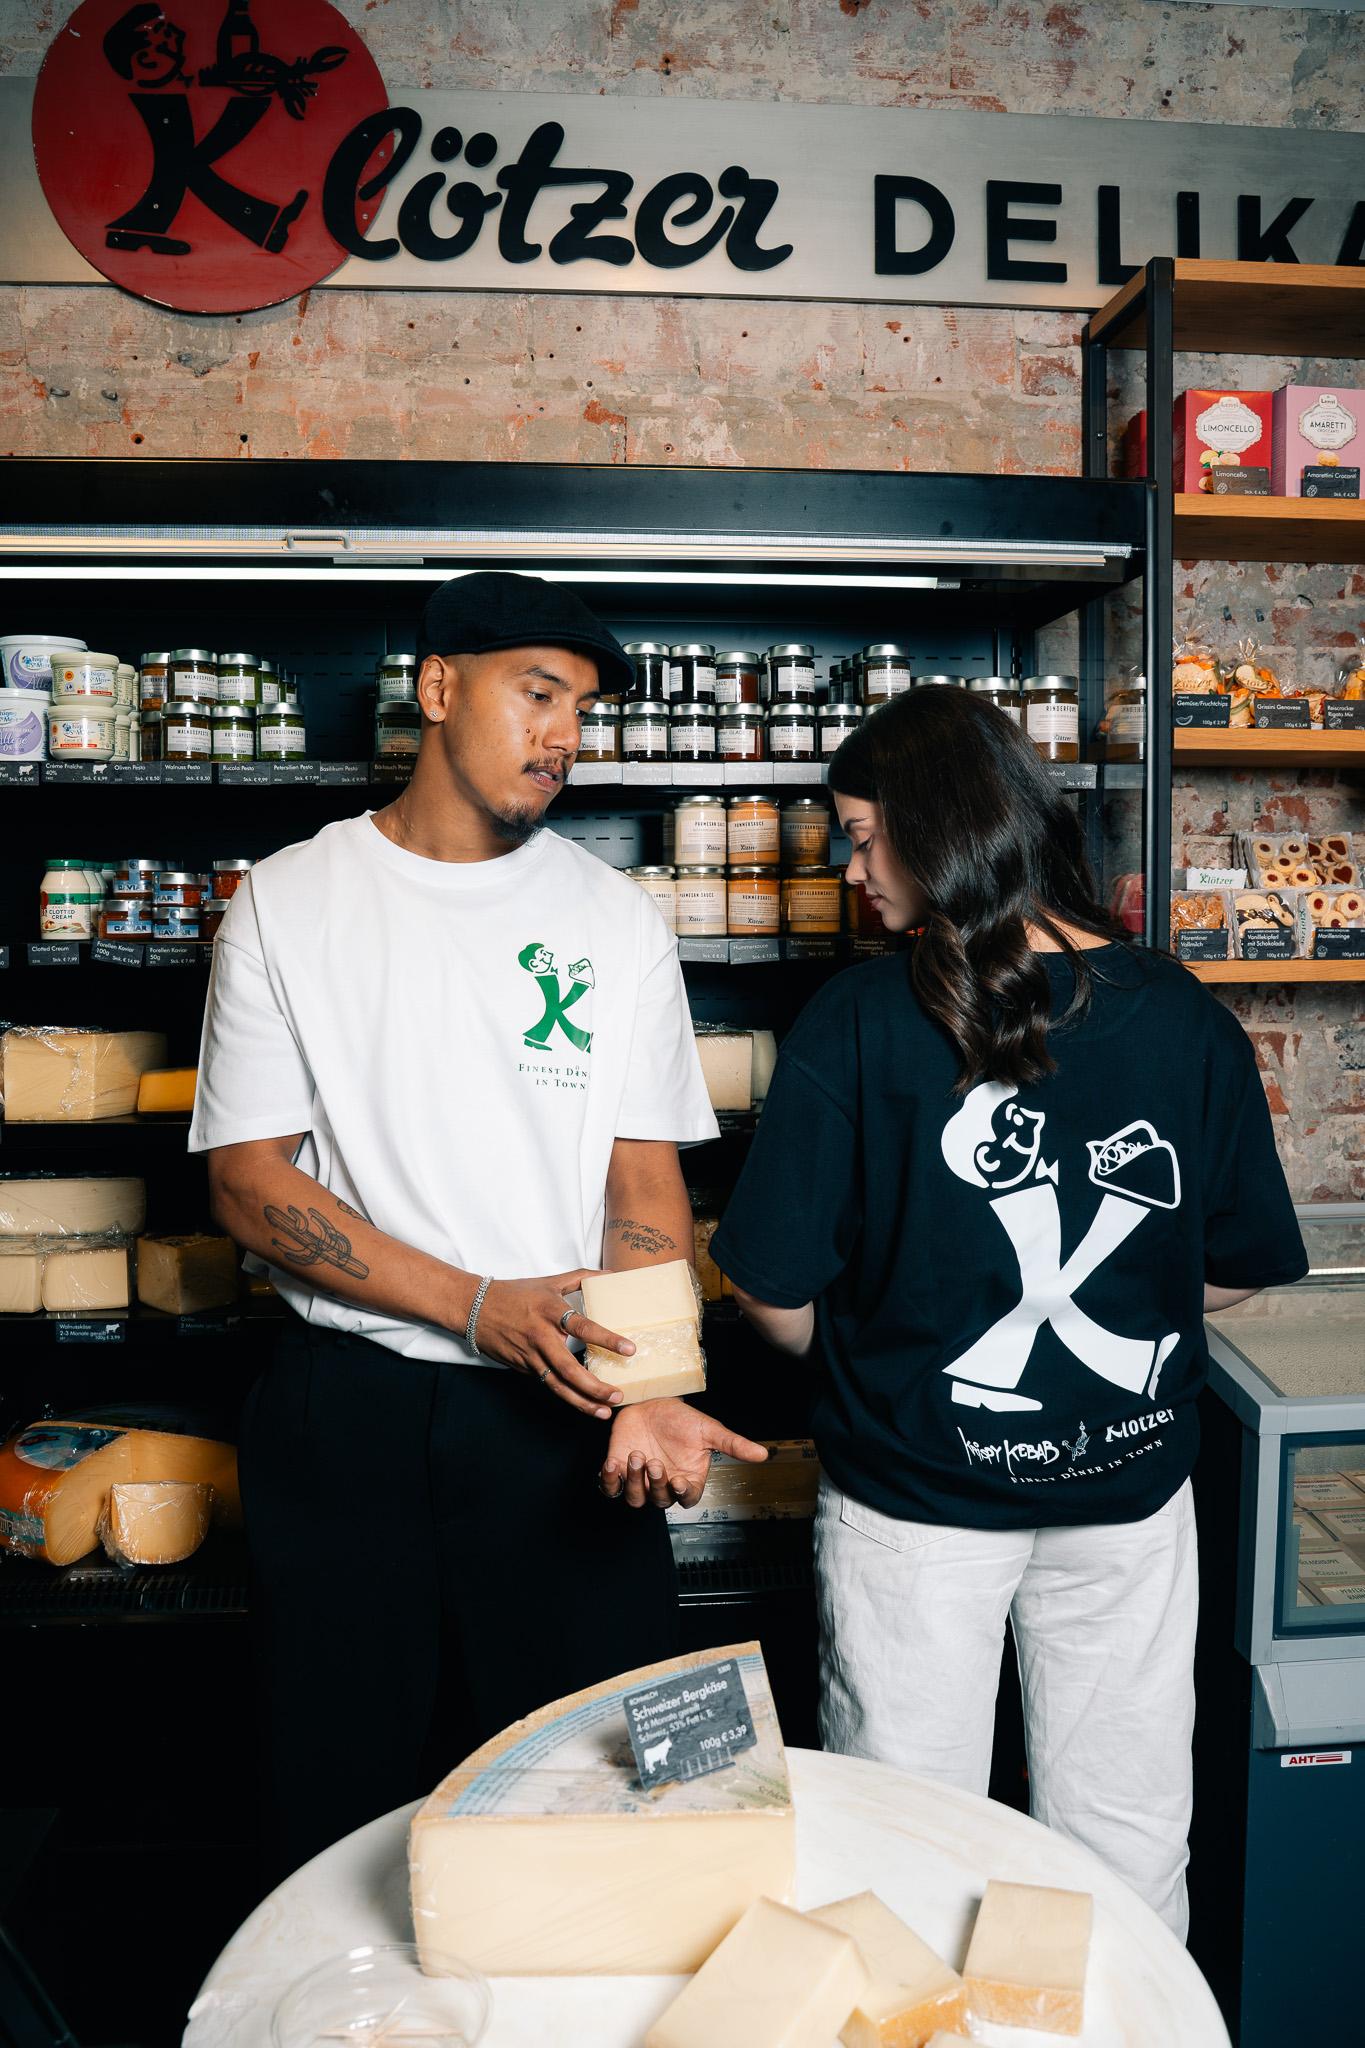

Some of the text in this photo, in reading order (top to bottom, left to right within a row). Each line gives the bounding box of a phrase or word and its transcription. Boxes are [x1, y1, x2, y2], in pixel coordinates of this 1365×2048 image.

[1203, 425, 1255, 433] LIMONCELLO
[1310, 421, 1347, 430] AMARETTI
[1215, 471, 1248, 479] Limoncello
[1200, 873, 1233, 885] Klötzer
[632, 1680, 728, 1722] Schweizer Bergkäse
[650, 1713, 678, 1728] Monate
[678, 1703, 700, 1719] gereift
[700, 1736, 721, 1751] 100g
[729, 1724, 748, 1740] 3,39
[1289, 1755, 1315, 1764] AHT
